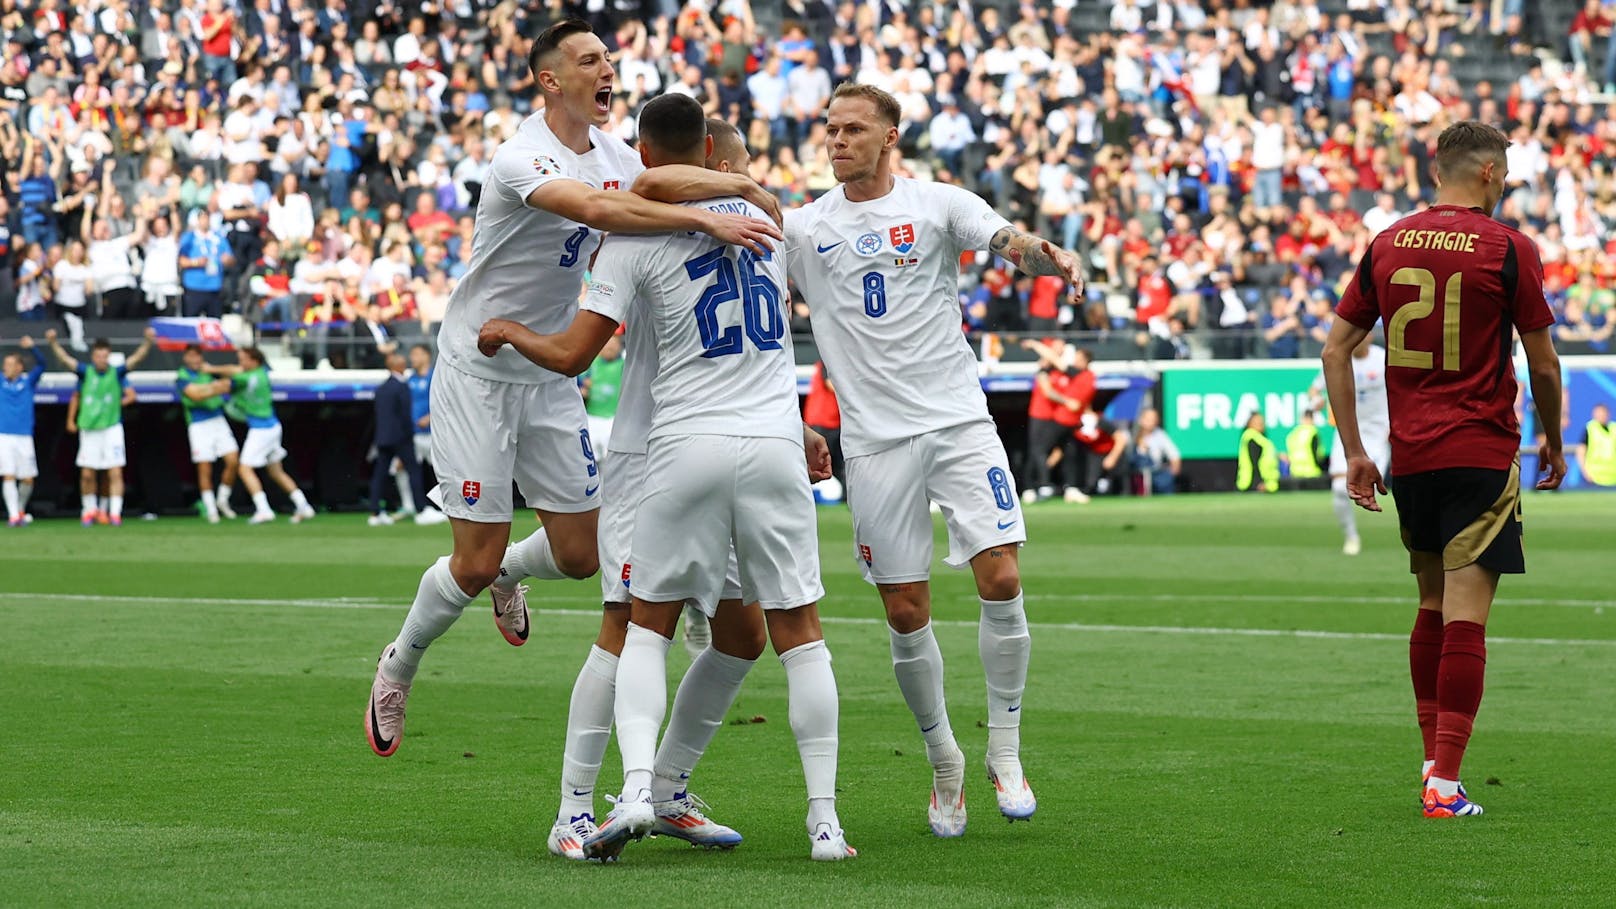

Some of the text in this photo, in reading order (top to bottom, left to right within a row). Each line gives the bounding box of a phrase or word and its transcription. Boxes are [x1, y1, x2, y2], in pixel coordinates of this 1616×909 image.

[559, 226, 589, 268] 9
[1393, 228, 1480, 253] CASTAGNE
[683, 241, 785, 358] 26
[862, 271, 887, 318] 8
[1387, 267, 1462, 372] 21
[579, 428, 597, 477] 9
[986, 466, 1015, 511] 8
